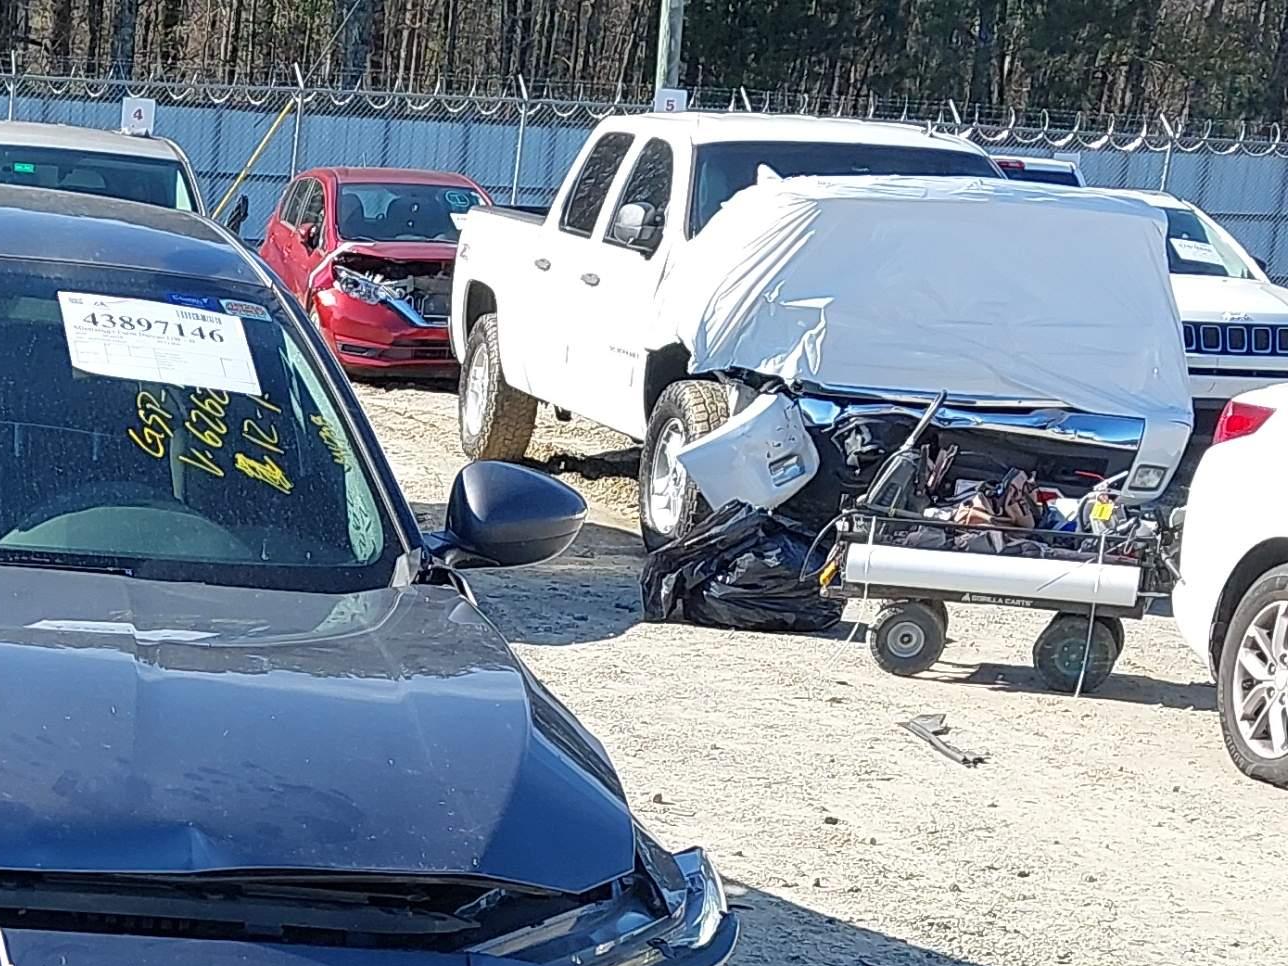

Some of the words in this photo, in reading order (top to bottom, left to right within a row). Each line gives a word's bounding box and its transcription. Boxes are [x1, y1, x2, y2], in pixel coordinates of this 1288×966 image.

[665, 99, 675, 112] 5
[133, 108, 144, 121] 4
[82, 312, 224, 342] 43897146
